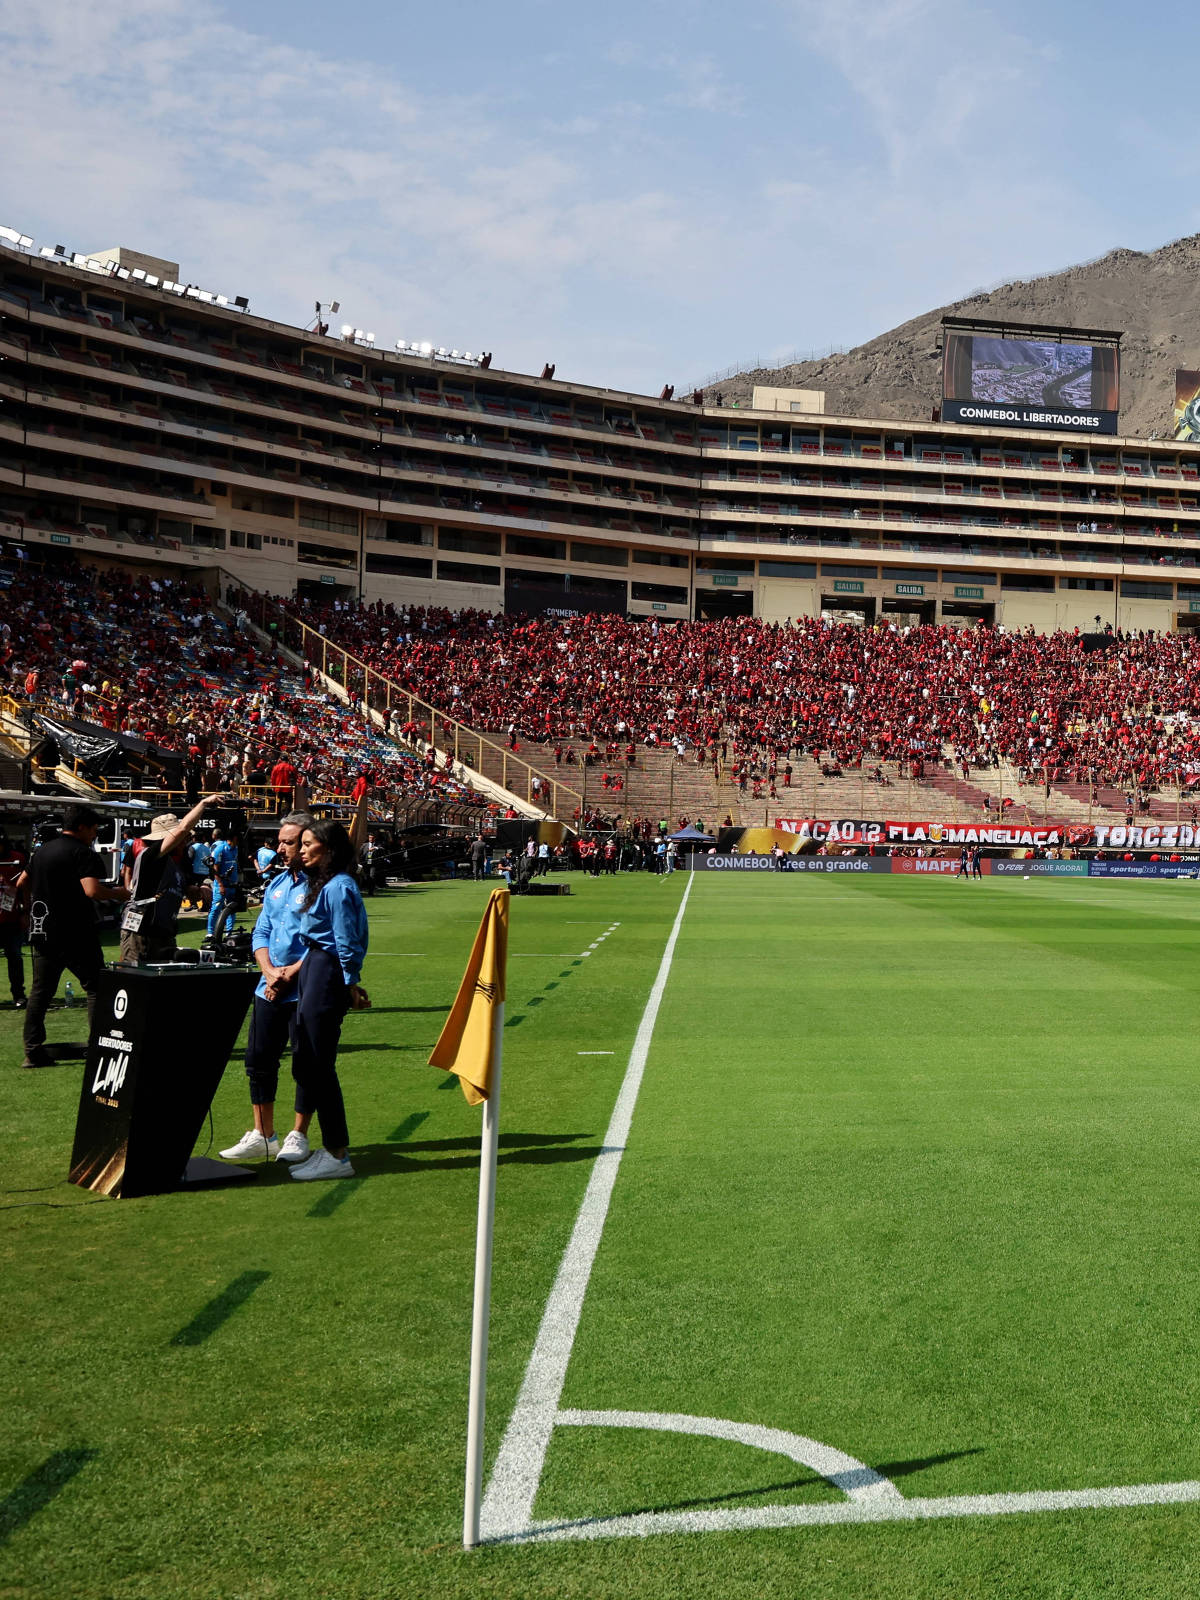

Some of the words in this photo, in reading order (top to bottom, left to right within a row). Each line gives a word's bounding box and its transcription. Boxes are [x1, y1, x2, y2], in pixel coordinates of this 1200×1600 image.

[959, 407, 1021, 421] CONMEBOL
[1023, 412, 1100, 427] LIBERTADORES
[836, 582, 861, 591] SALIDA
[897, 585, 922, 595] SALIDA
[957, 588, 981, 598] SALIDA
[860, 823, 881, 842] 12
[889, 826, 927, 841] FLA
[948, 828, 1060, 848] MANGUAÇA
[706, 857, 775, 869] CONMEBOL
[808, 861, 824, 869] en
[915, 860, 982, 872] MAPF
[1054, 864, 1084, 872] AGORA!
[92, 1052, 129, 1097] LIMA
